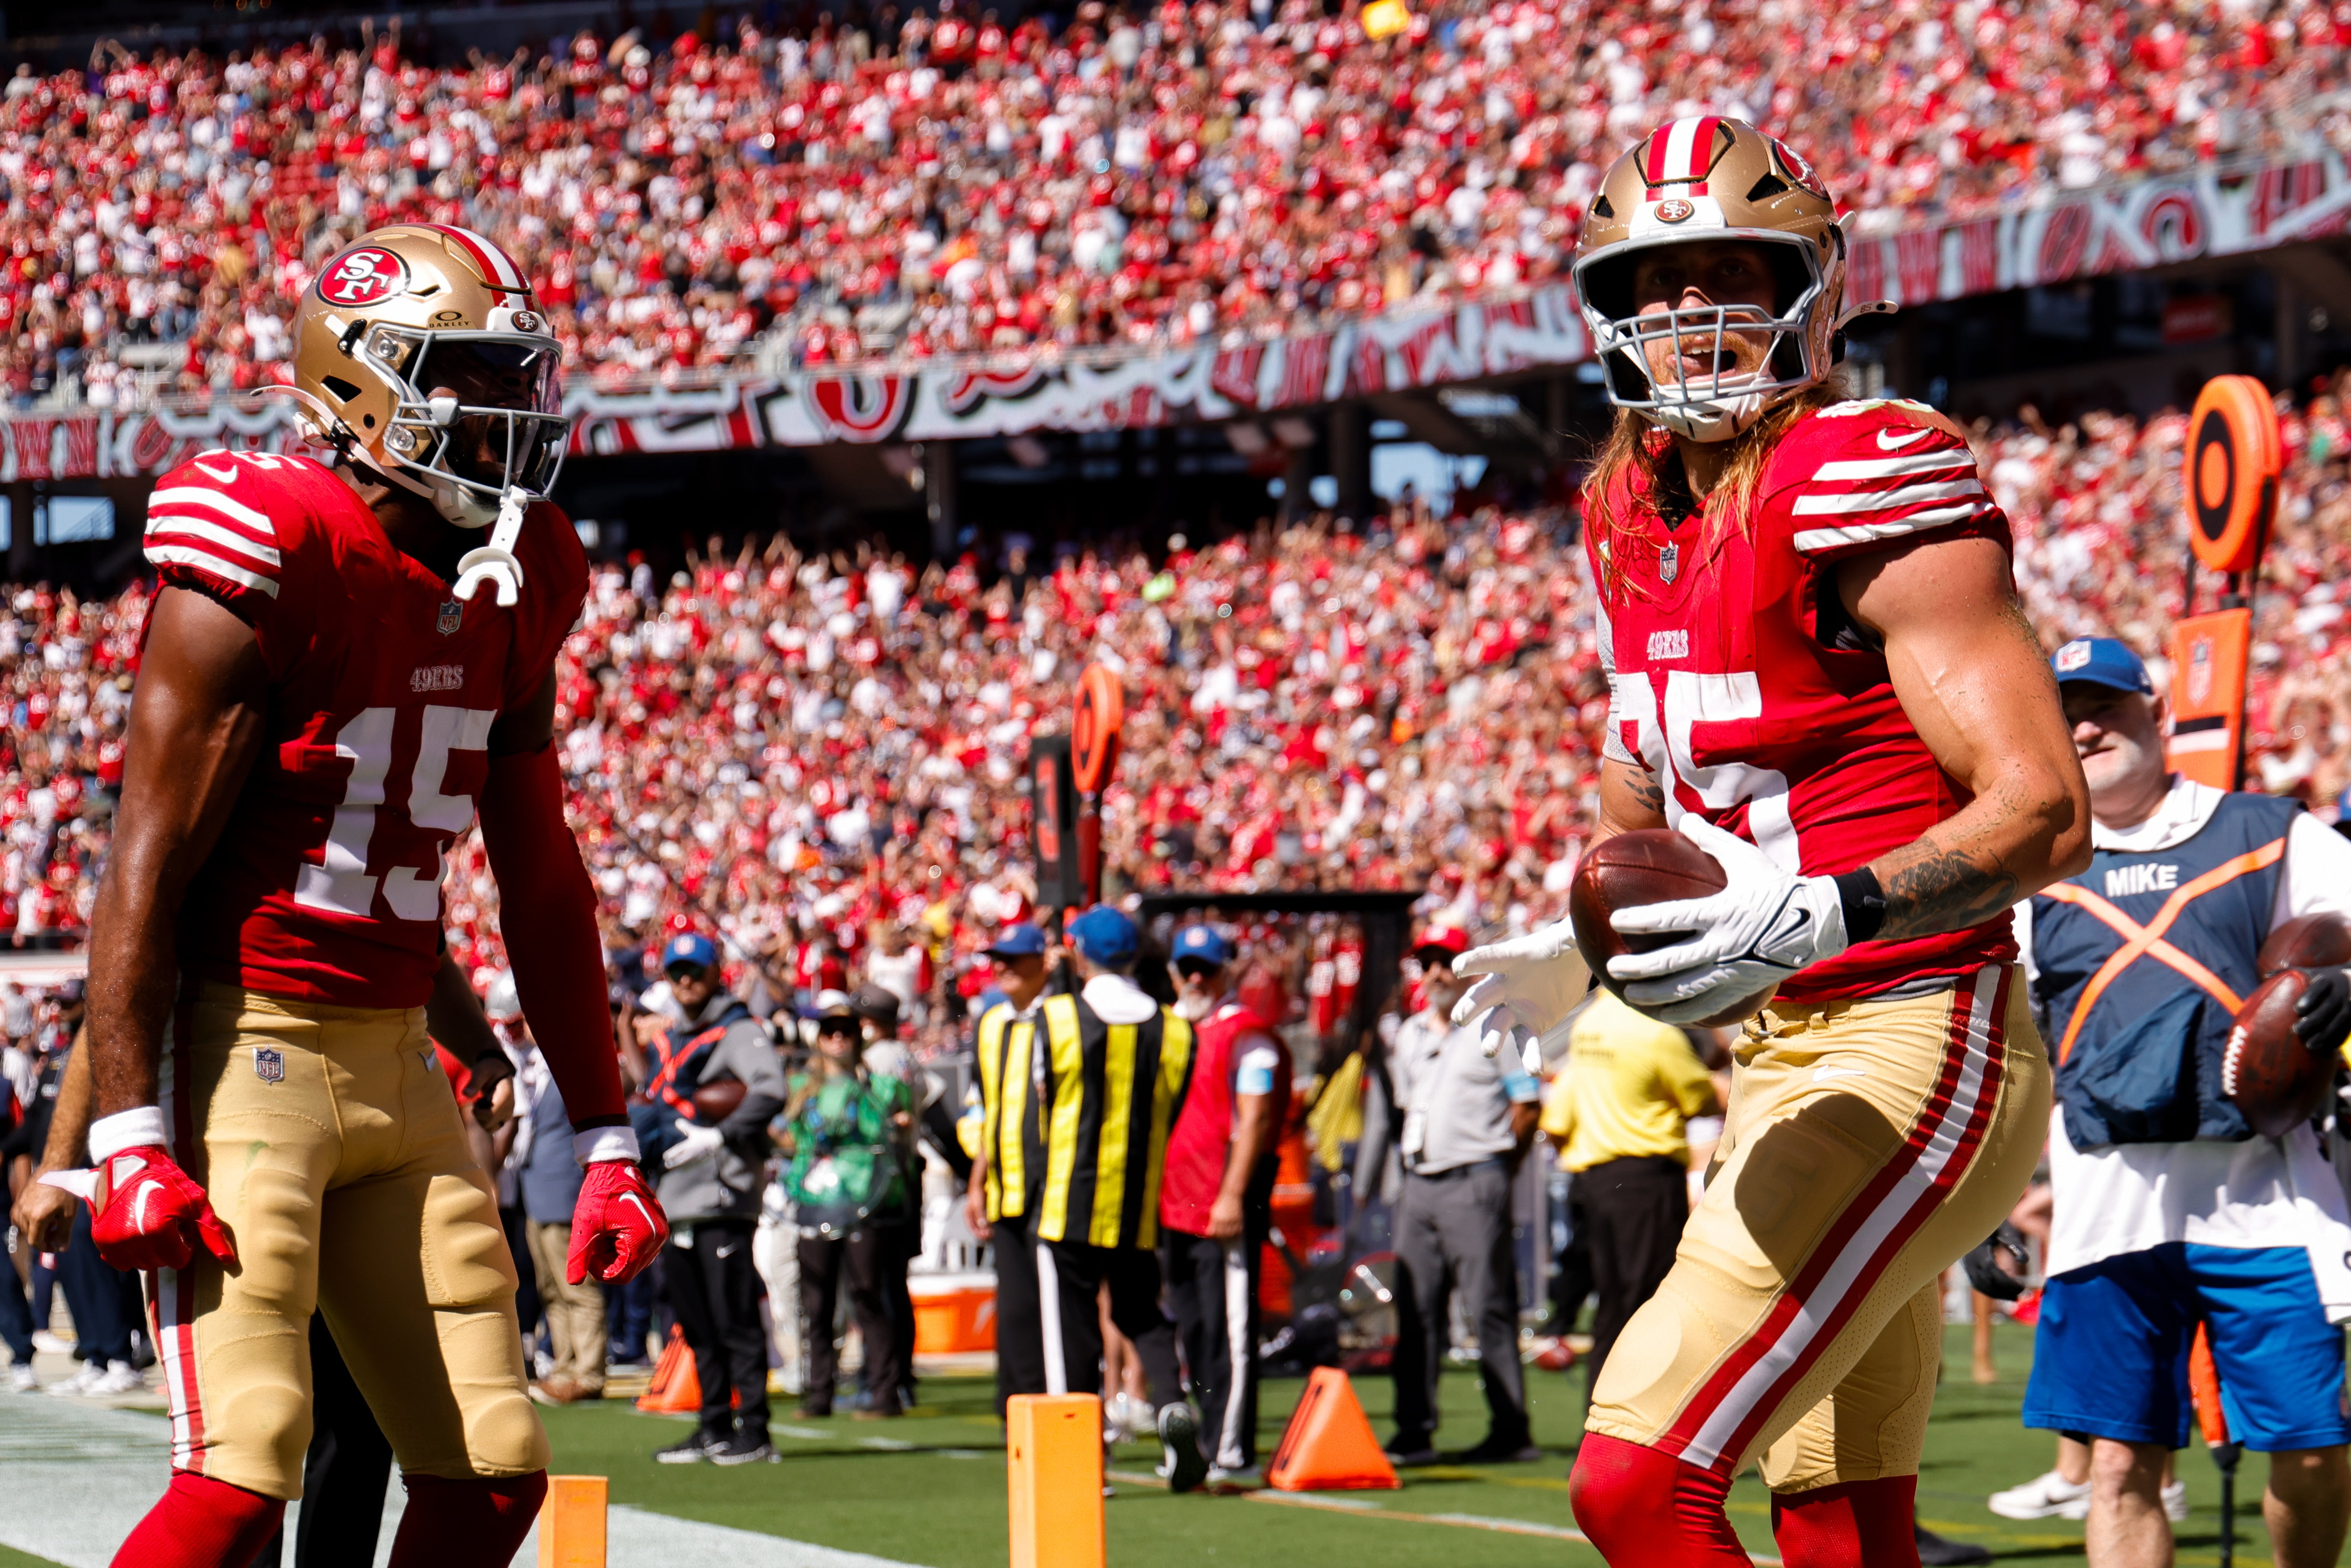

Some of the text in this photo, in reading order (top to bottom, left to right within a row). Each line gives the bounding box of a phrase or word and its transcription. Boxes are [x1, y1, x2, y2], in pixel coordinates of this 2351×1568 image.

[1646, 629, 1689, 661] 49ERS
[409, 664, 463, 692] 49ERS
[294, 704, 498, 921] 15
[2105, 863, 2179, 898] MIKE
[259, 1061, 280, 1077] NFL
